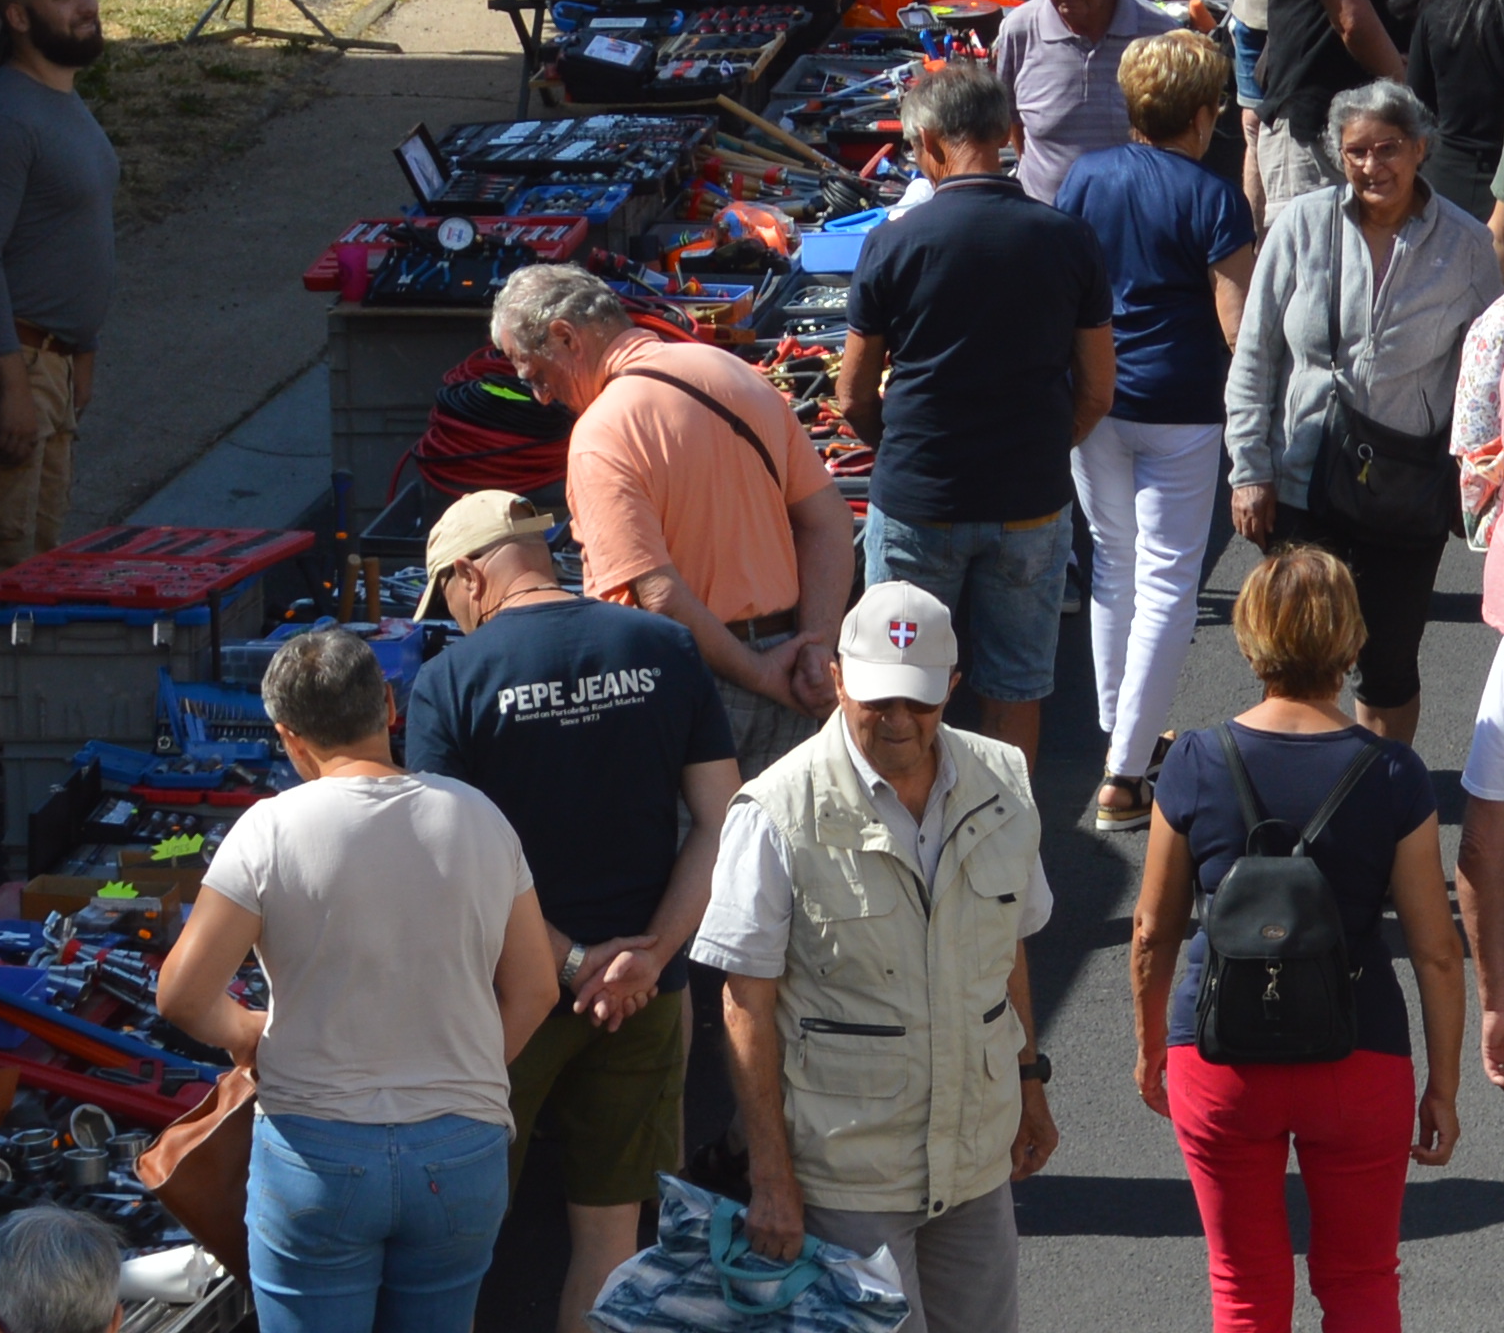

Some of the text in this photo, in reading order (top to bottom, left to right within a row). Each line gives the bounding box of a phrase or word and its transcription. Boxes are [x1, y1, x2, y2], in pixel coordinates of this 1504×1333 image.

[498, 668, 656, 715] PEPE JEANS
[515, 695, 645, 722] Based on Portobello Road Market
[560, 712, 600, 727] Since 1973
